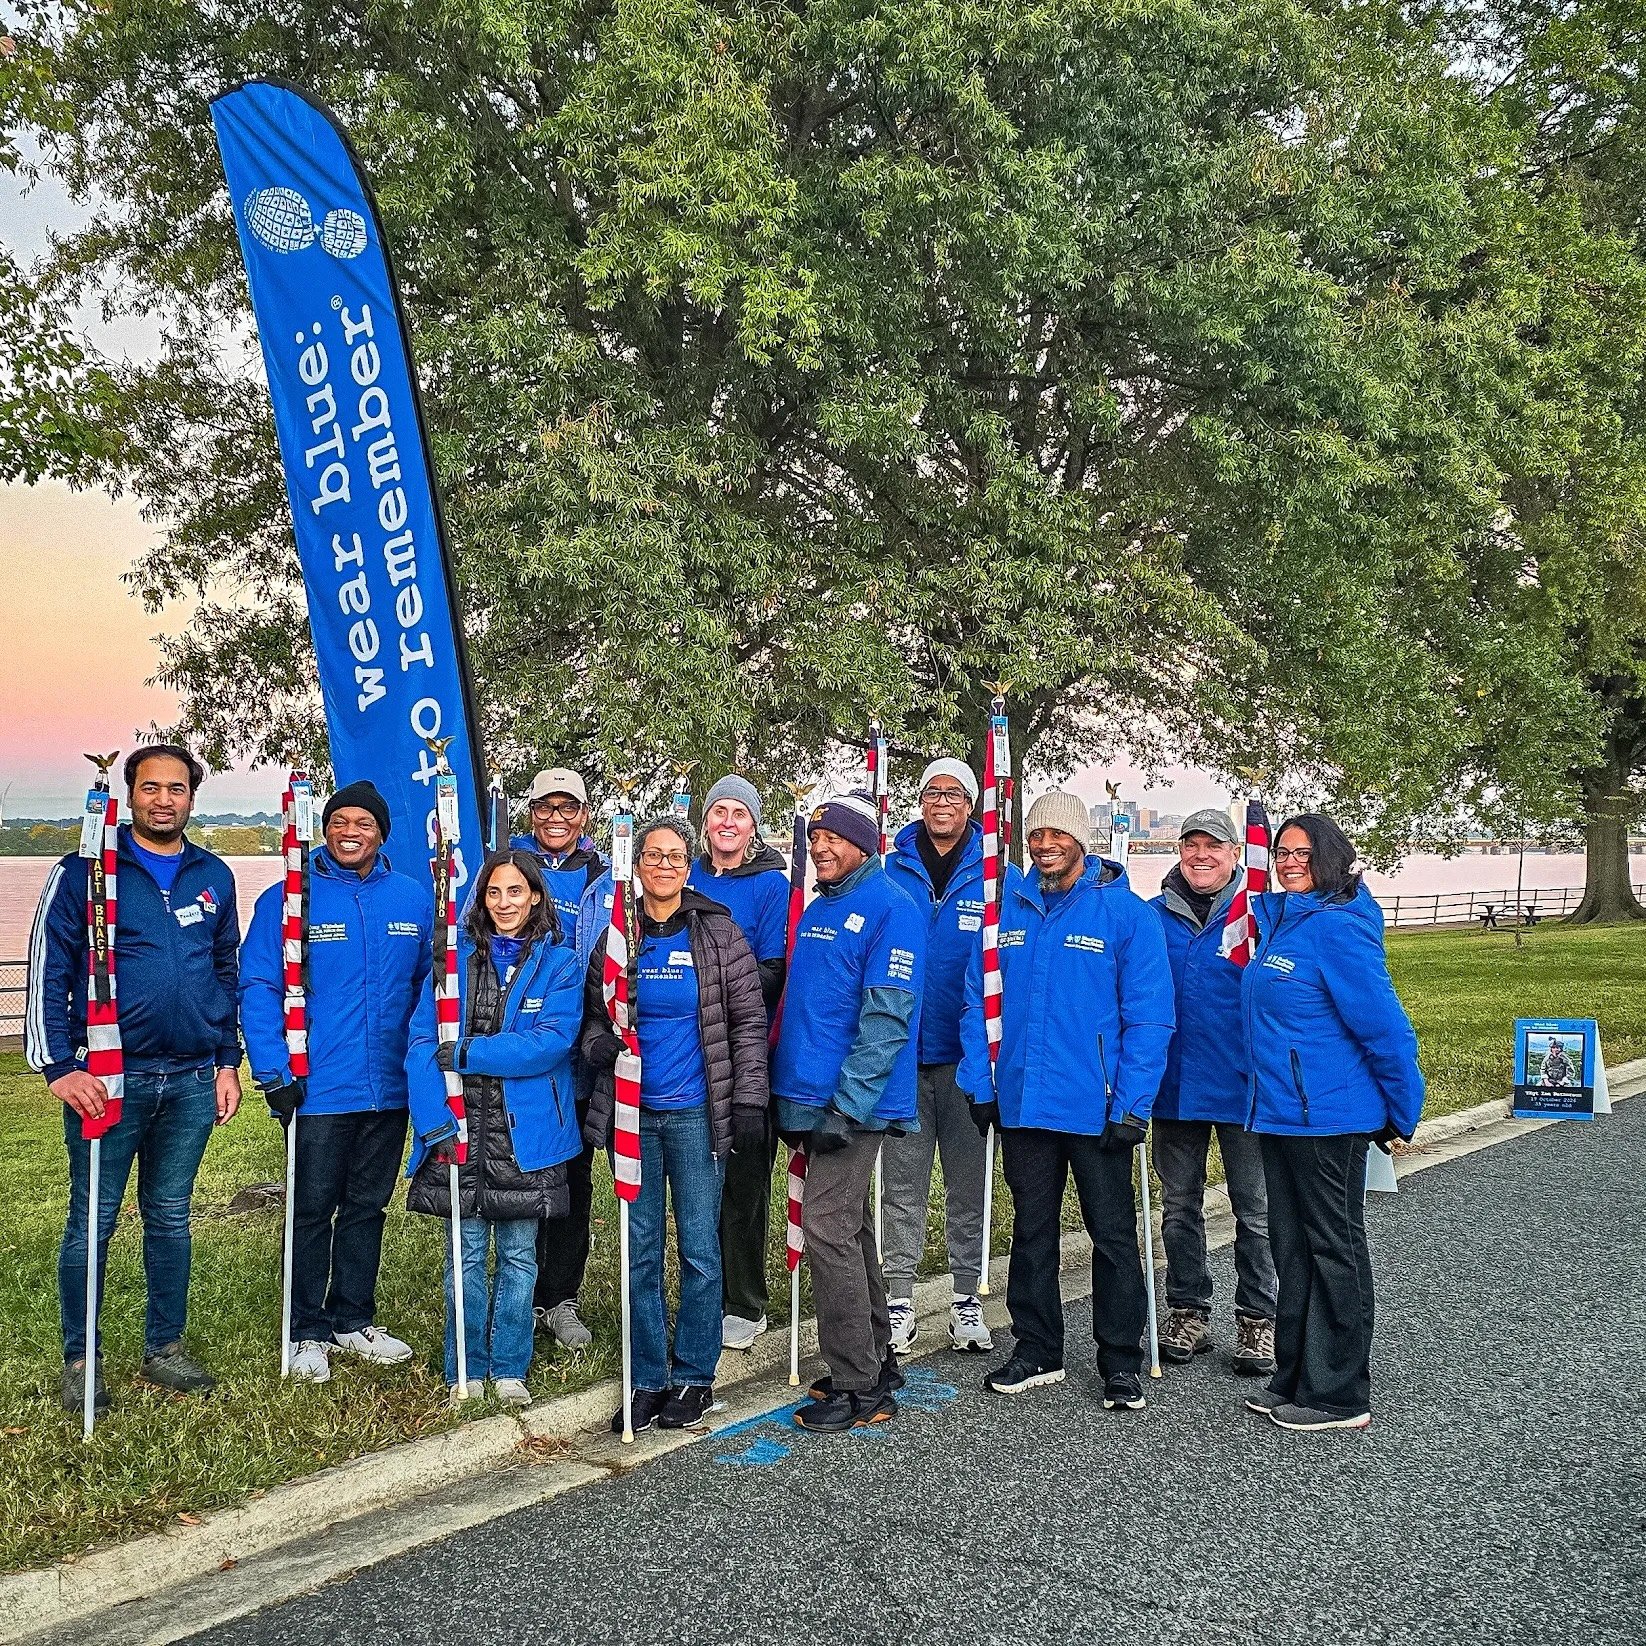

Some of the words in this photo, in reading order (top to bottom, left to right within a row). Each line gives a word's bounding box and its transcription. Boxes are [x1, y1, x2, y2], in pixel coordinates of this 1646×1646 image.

[322, 210, 337, 255] FIGHTING
[348, 211, 368, 259] FAMILIES
[295, 321, 351, 516] blue:
[331, 531, 388, 713] wear
[410, 697, 443, 787] to
[93, 859, 103, 894] APT
[438, 868, 448, 919] SAVINO
[94, 904, 105, 962] BRACY
